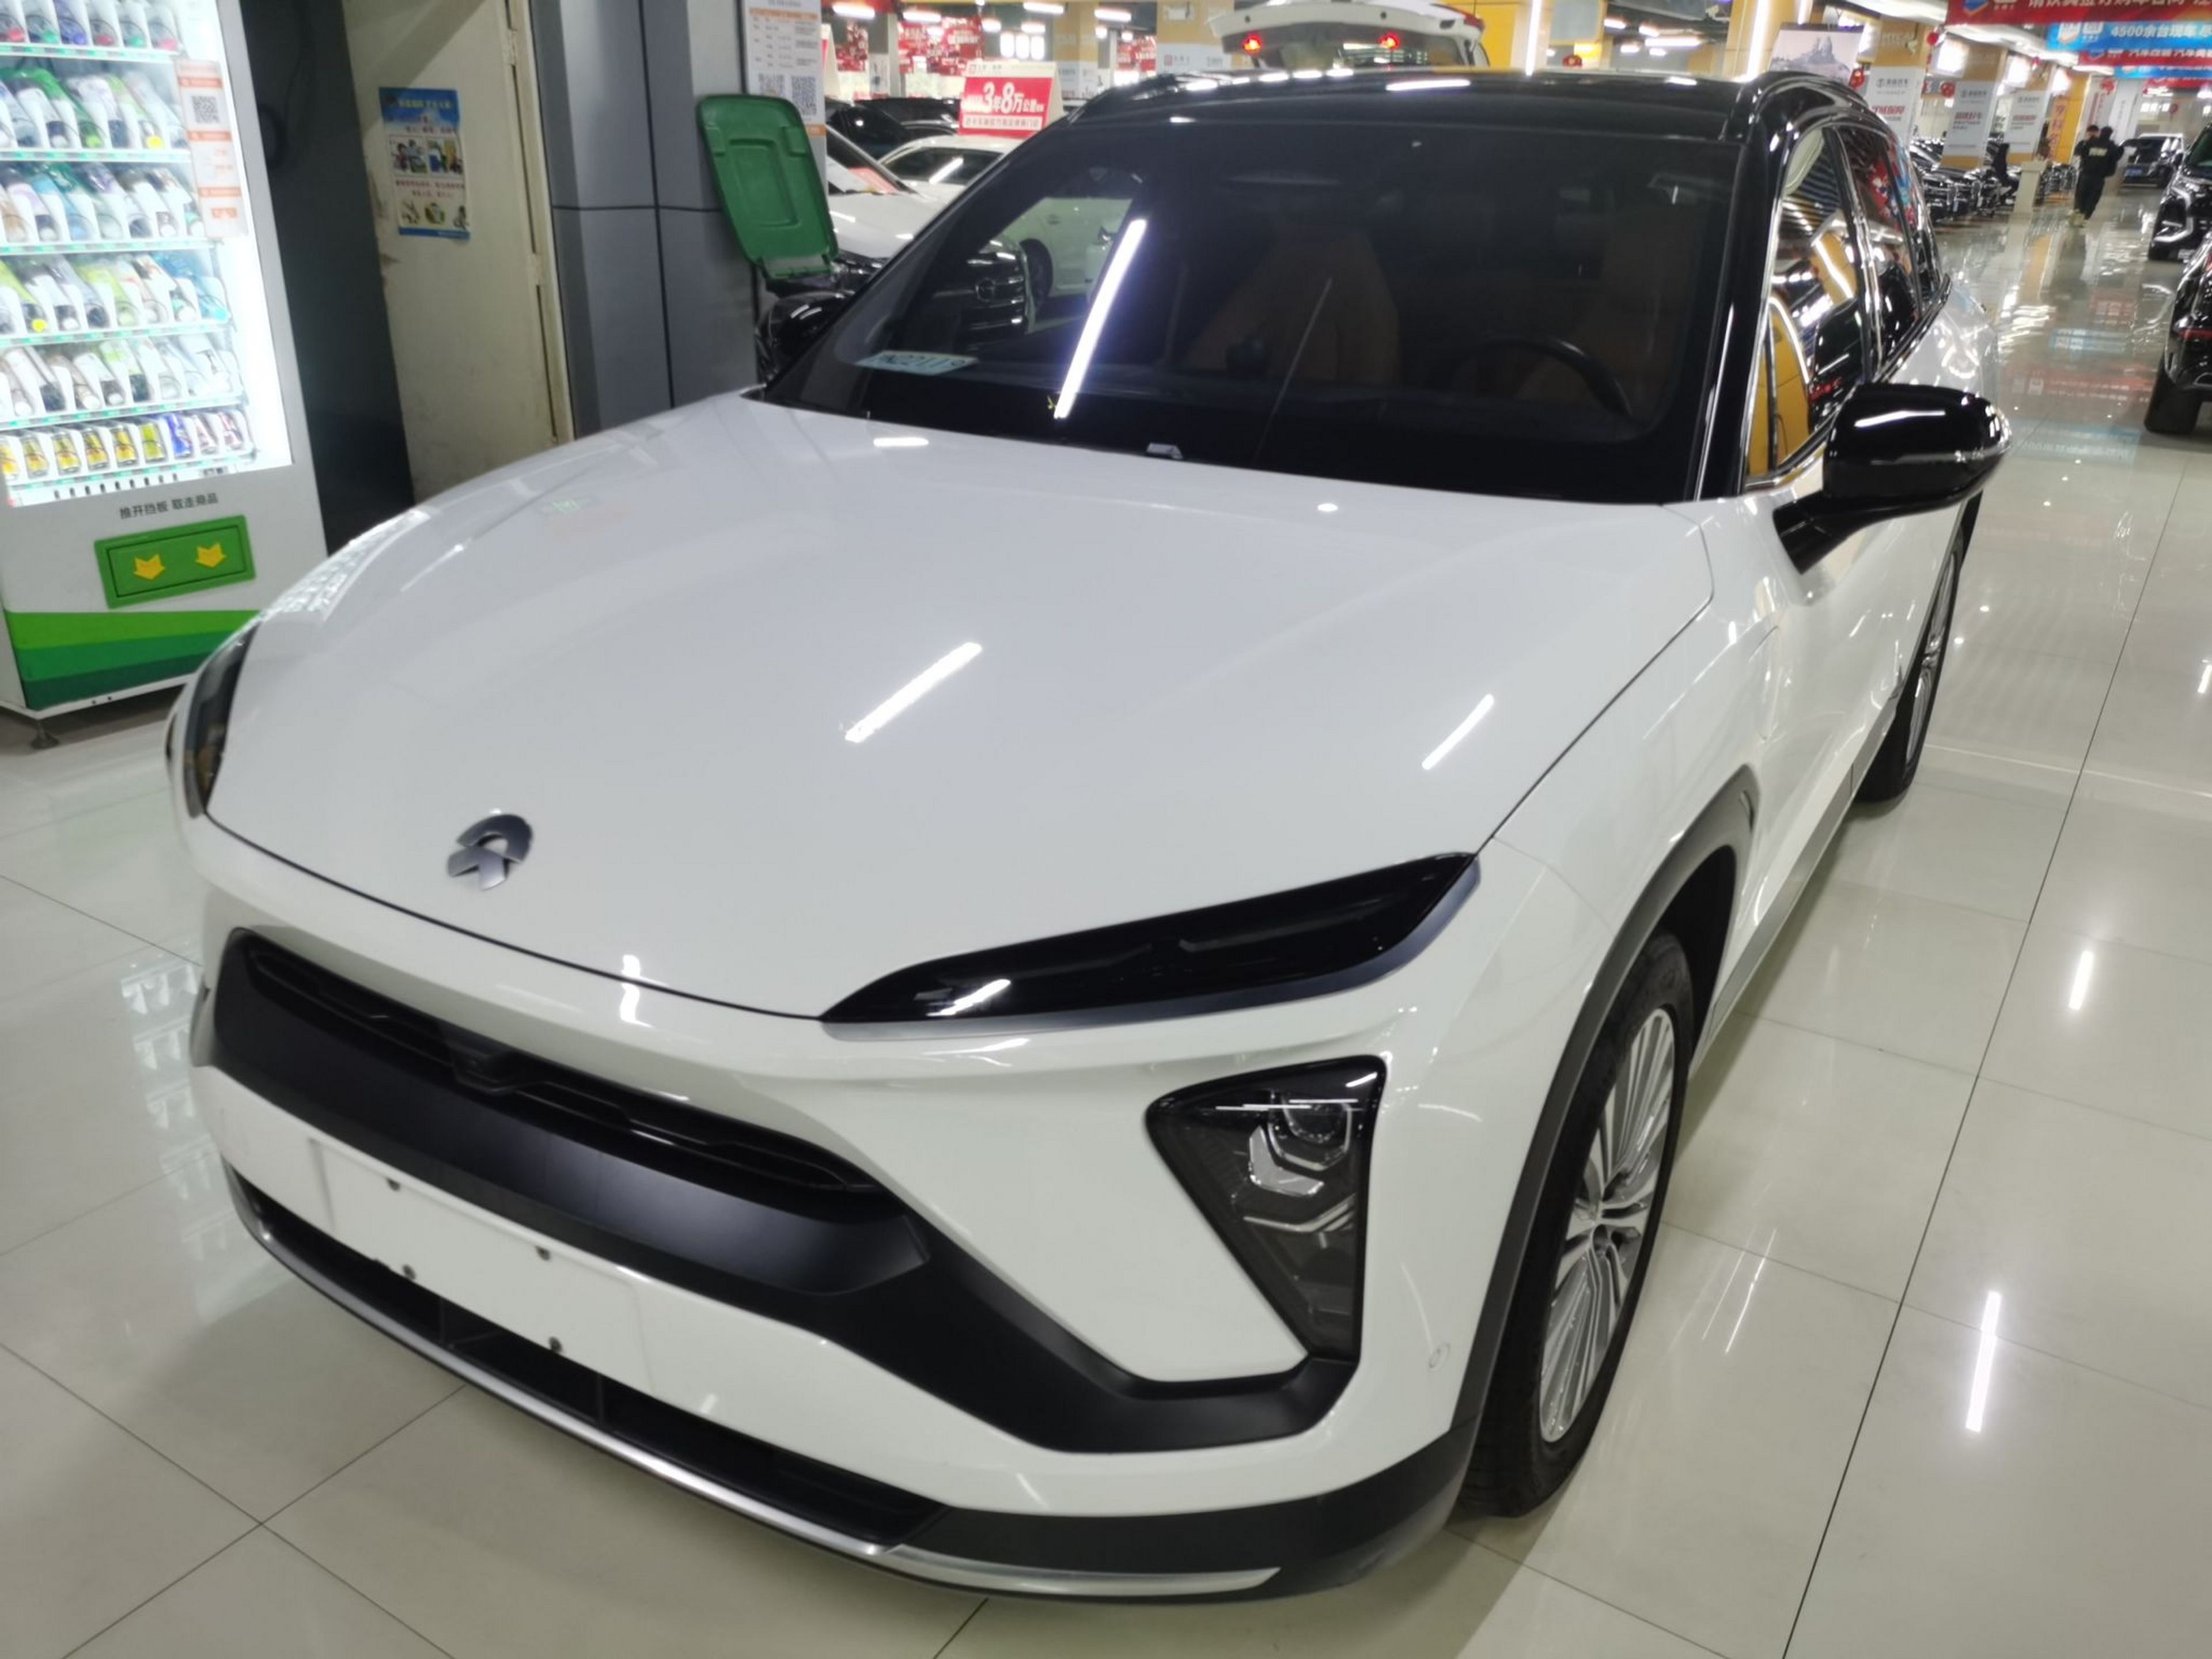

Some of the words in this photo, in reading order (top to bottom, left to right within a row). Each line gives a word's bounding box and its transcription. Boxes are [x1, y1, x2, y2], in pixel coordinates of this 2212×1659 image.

[119, 501, 168, 520] 推开挡板
[172, 493, 219, 510] 取走商品
